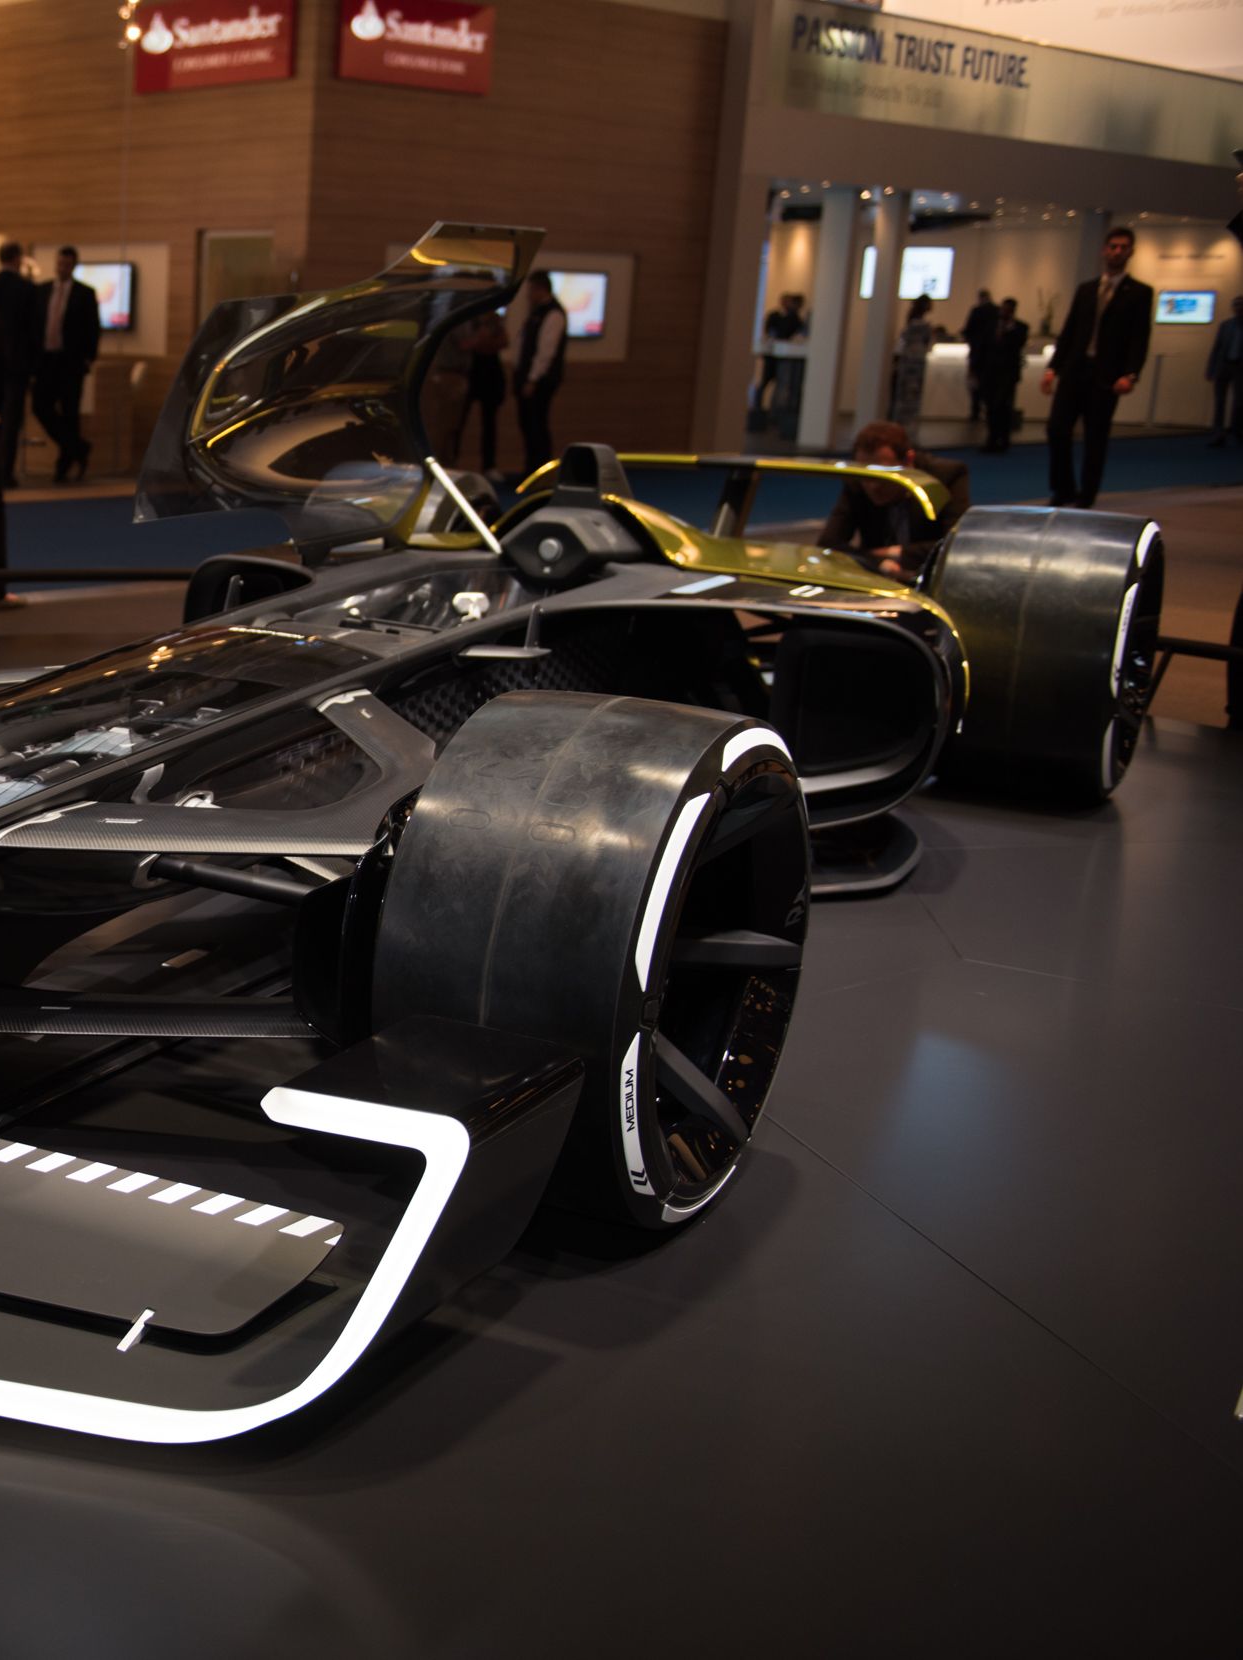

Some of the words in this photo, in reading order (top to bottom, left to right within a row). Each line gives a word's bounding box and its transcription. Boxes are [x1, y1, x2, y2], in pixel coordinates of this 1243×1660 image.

[173, 5, 283, 49] Santander
[384, 9, 487, 54] Santander
[625, 1068, 635, 1132] MEDIUM
